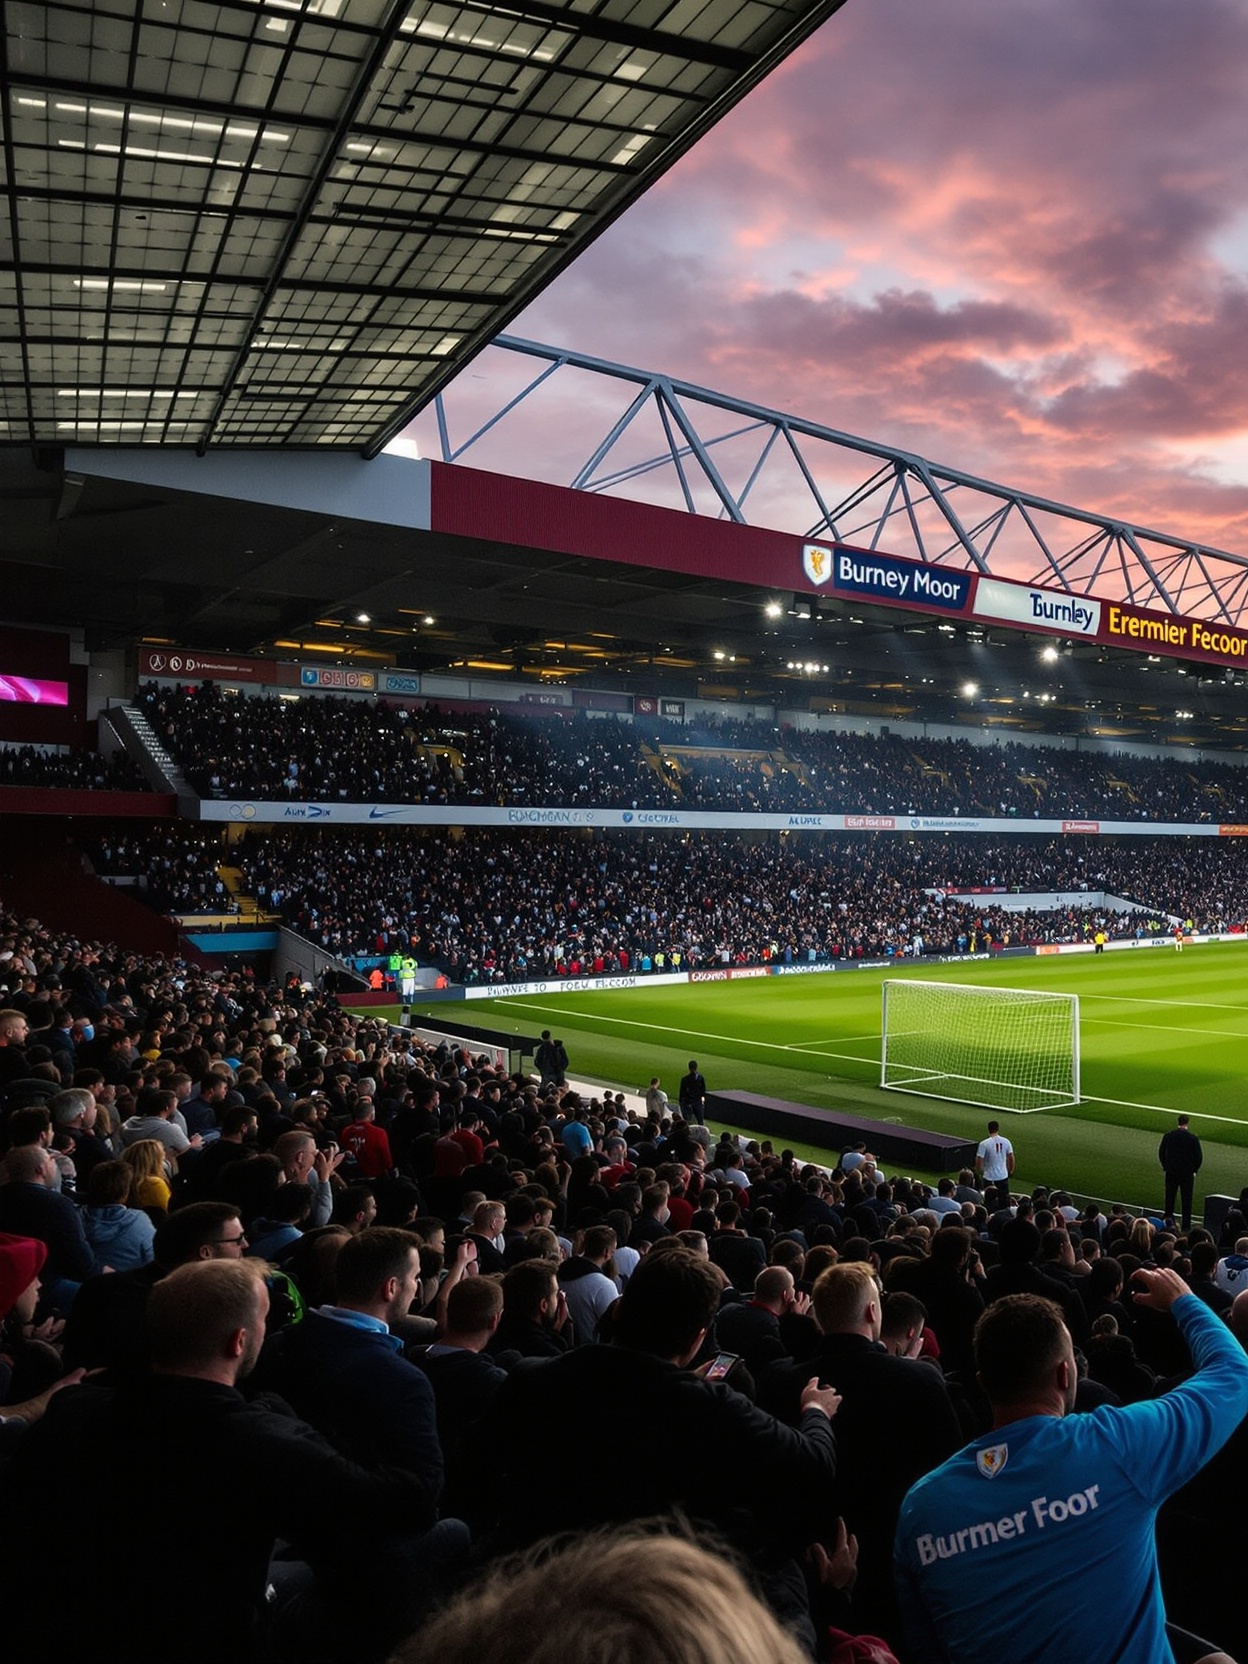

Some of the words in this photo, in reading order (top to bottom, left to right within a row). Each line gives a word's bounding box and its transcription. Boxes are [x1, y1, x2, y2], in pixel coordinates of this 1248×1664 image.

[839, 556, 909, 595] Burney
[914, 569, 961, 601] Moor
[1192, 623, 1248, 656] Fecoor
[916, 1509, 1028, 1567] Burmer
[1031, 1484, 1100, 1529] Foor
